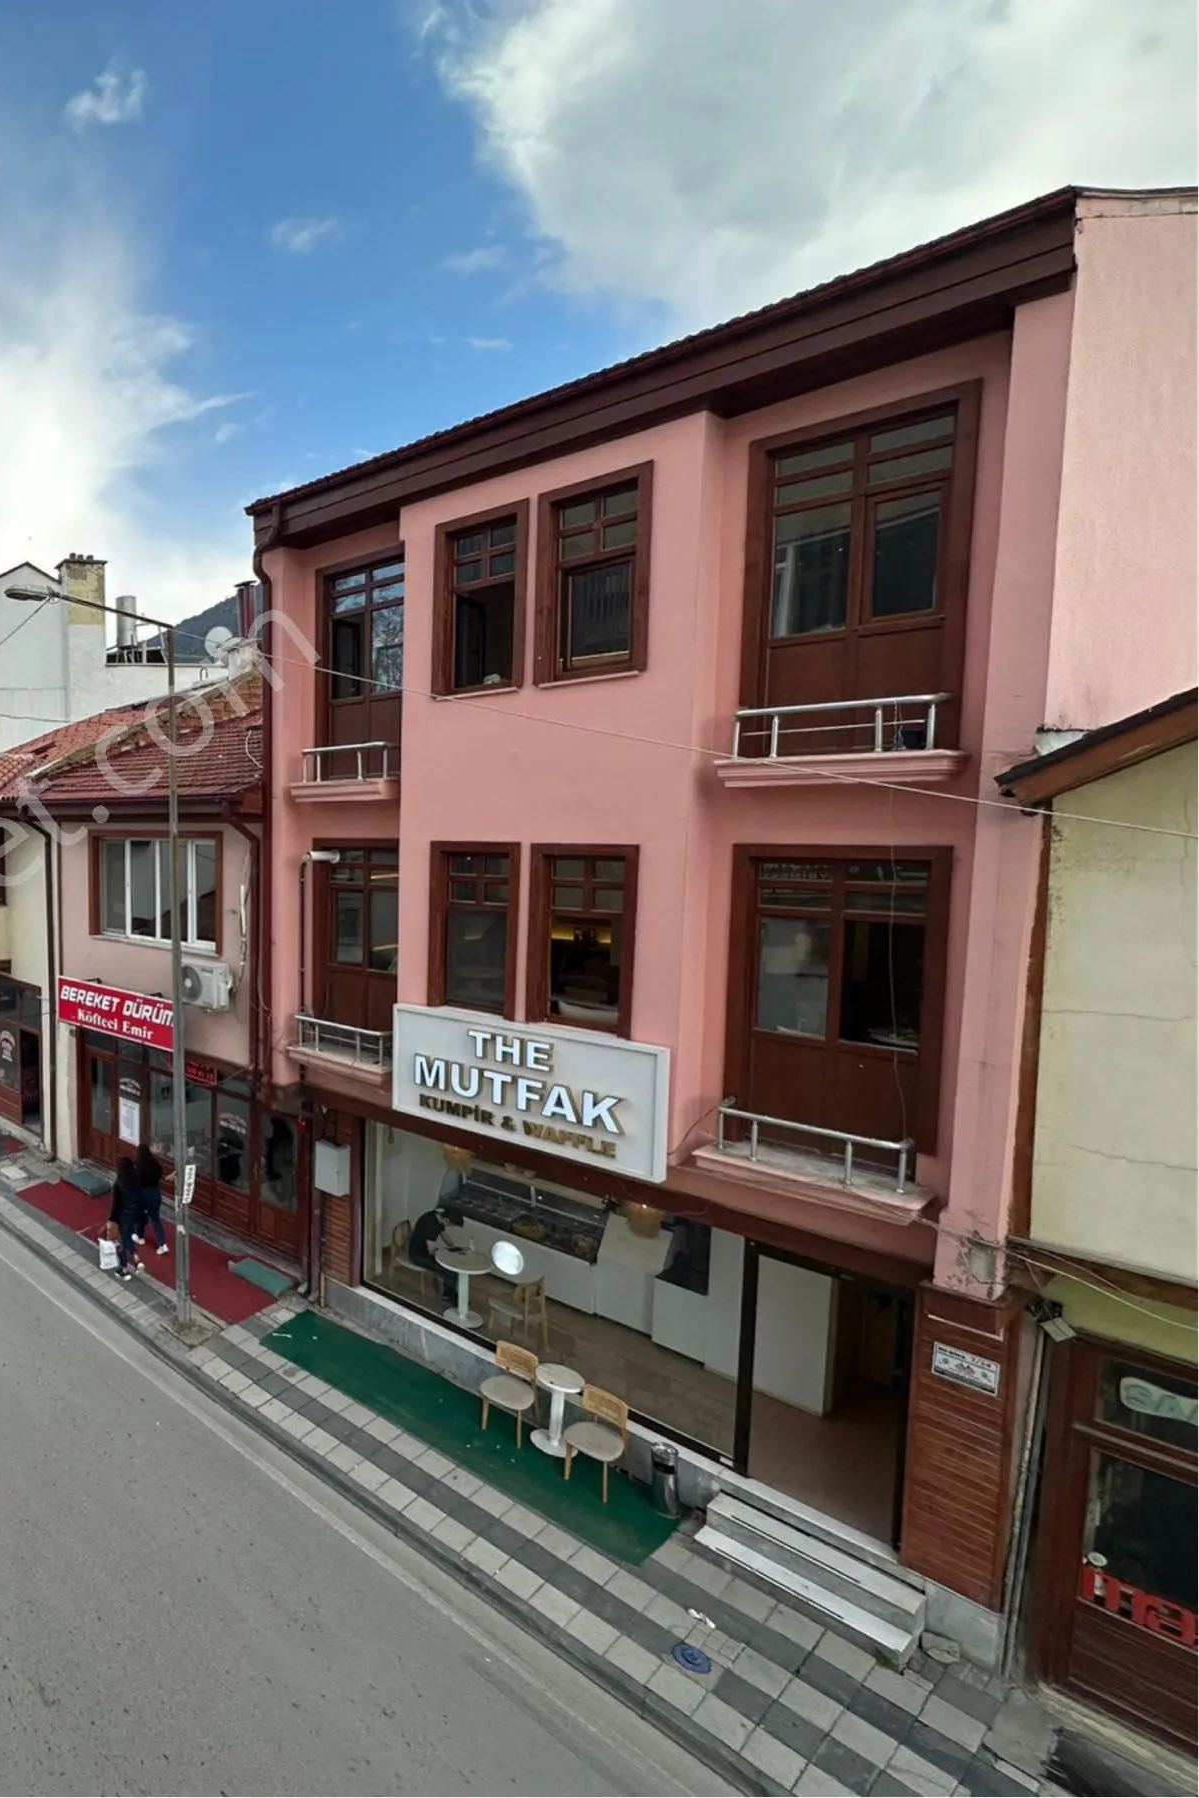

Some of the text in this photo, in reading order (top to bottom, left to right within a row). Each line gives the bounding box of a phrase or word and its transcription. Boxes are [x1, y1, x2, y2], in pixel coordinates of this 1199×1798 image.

[60, 985, 120, 1013] BEREKET
[77, 1008, 154, 1040] Köfteci Emir
[467, 1029, 554, 1073] THE
[414, 1053, 625, 1135] MUTFAK
[418, 1093, 617, 1158] KUMPİR & WAFFLE
